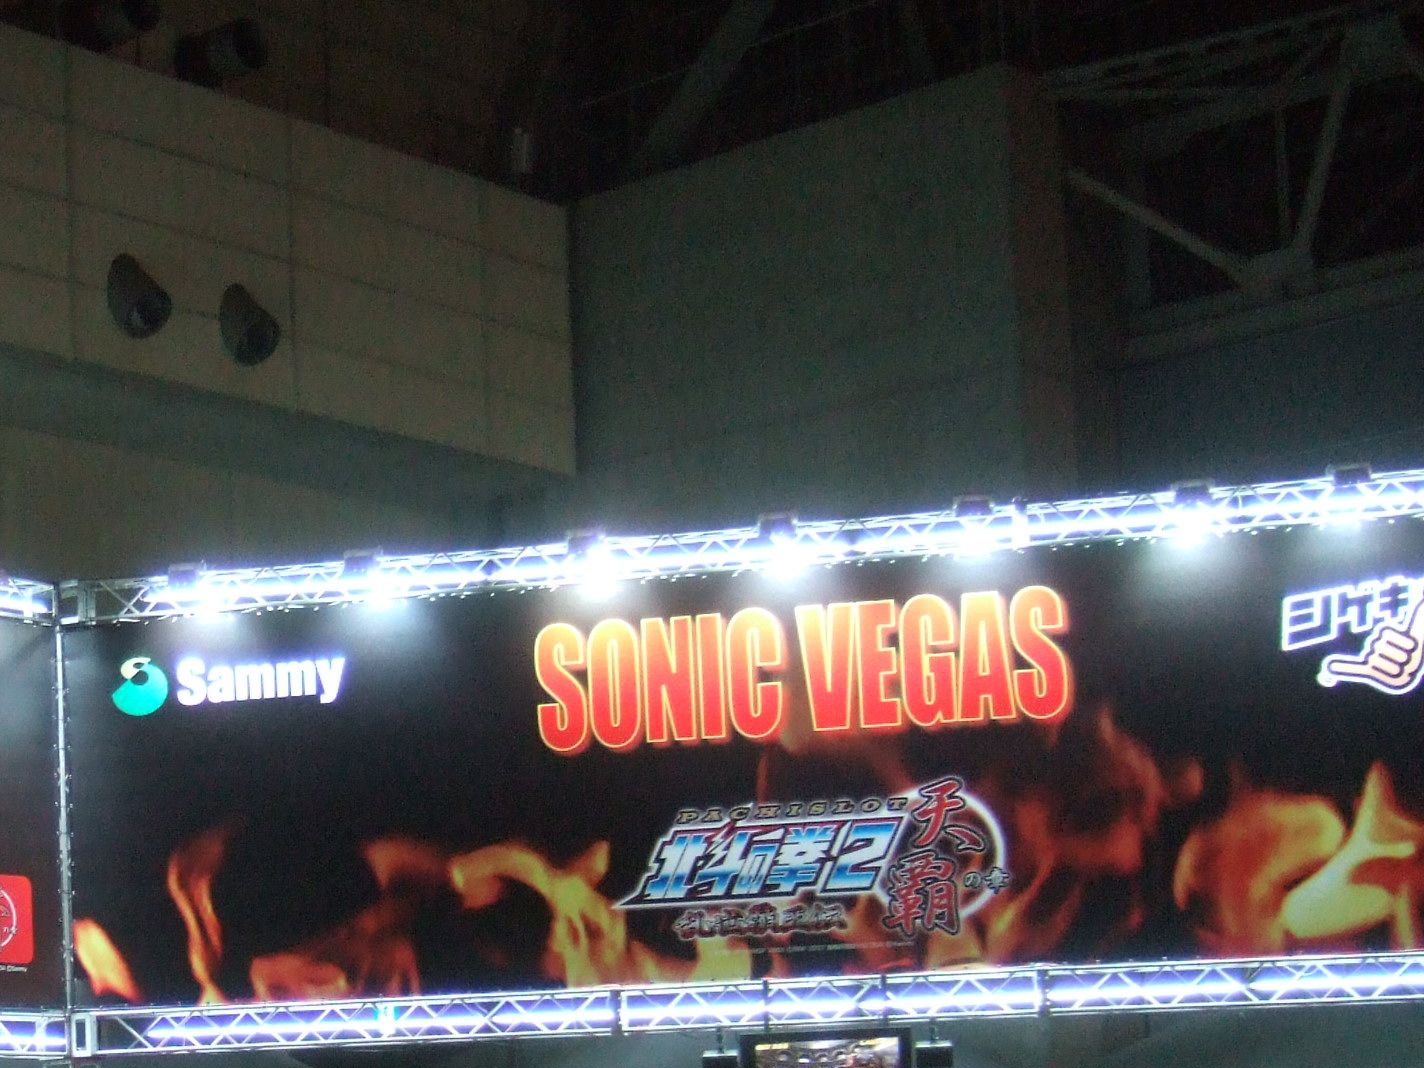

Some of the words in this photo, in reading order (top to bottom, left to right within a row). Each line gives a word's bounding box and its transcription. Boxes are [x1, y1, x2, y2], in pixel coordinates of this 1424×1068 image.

[176, 654, 346, 706] Sammy
[535, 607, 784, 752] SONIC
[794, 585, 1069, 731] VEGAS
[676, 797, 909, 825] PACHISLOT
